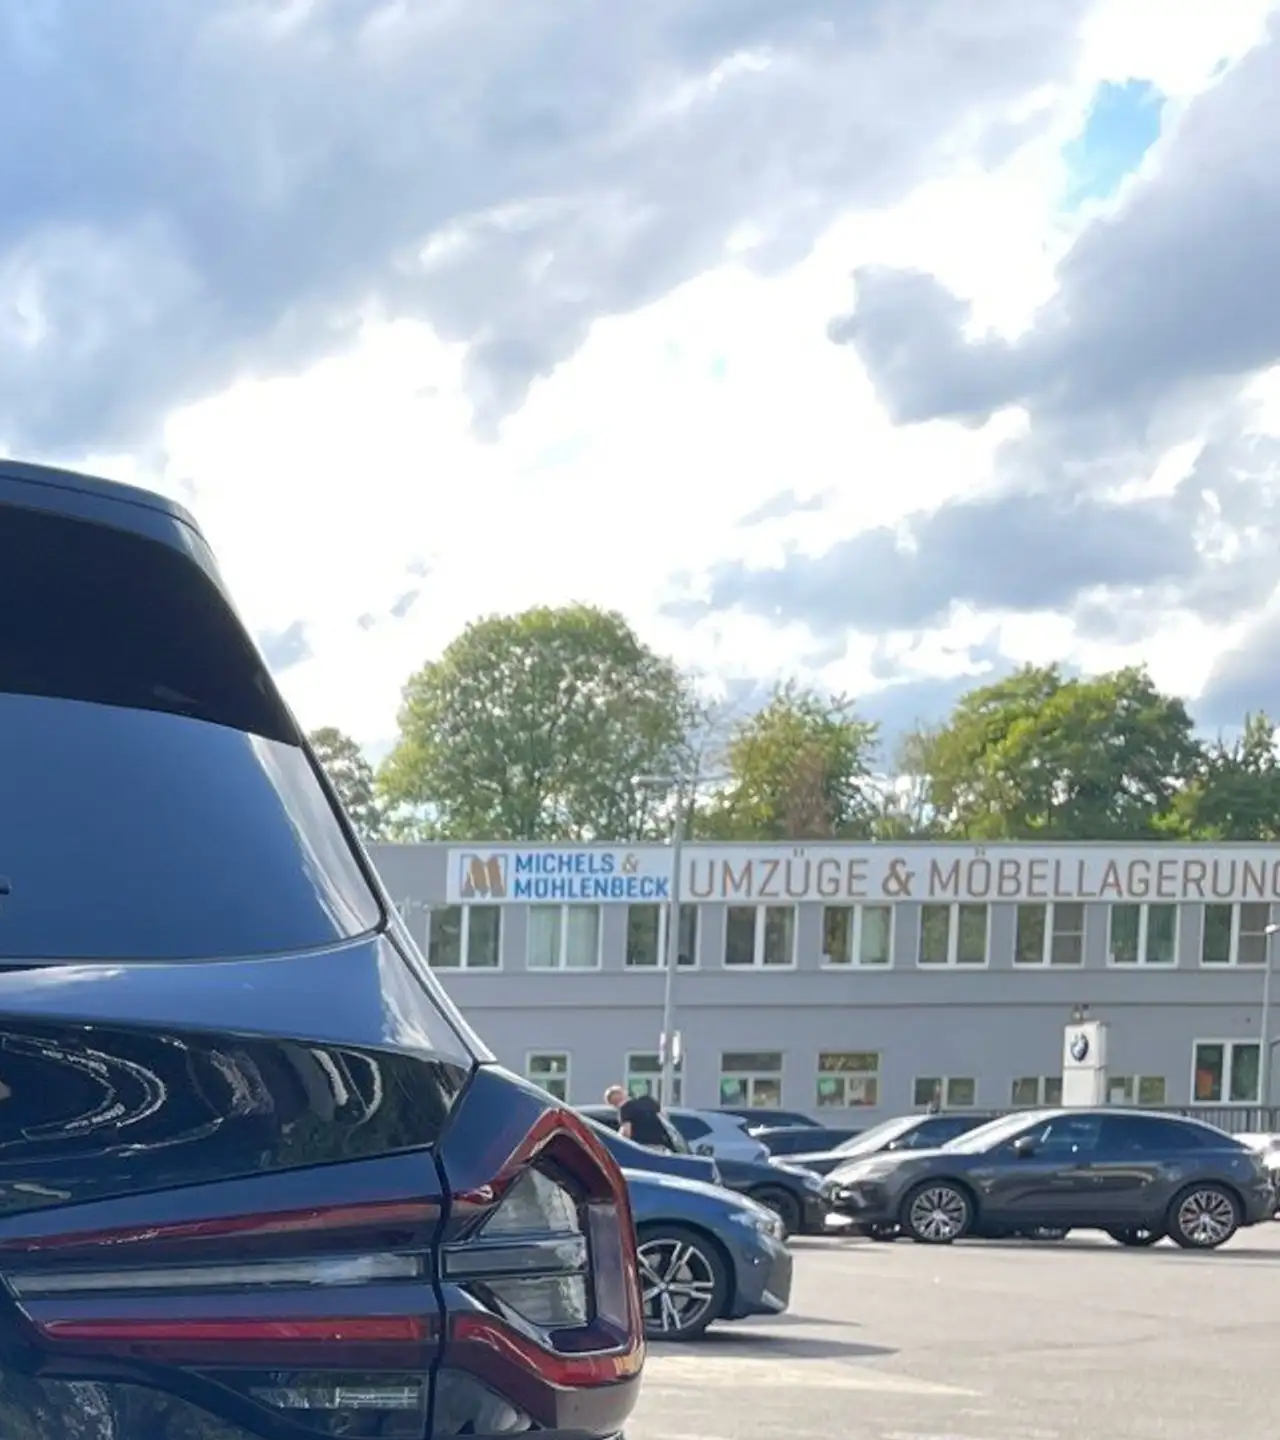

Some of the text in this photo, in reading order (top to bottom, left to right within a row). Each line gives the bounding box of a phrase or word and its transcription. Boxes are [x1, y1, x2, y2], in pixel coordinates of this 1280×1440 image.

[515, 853, 639, 873] MICHELS &
[690, 848, 869, 897] UMZÜGE
[882, 857, 916, 897] &
